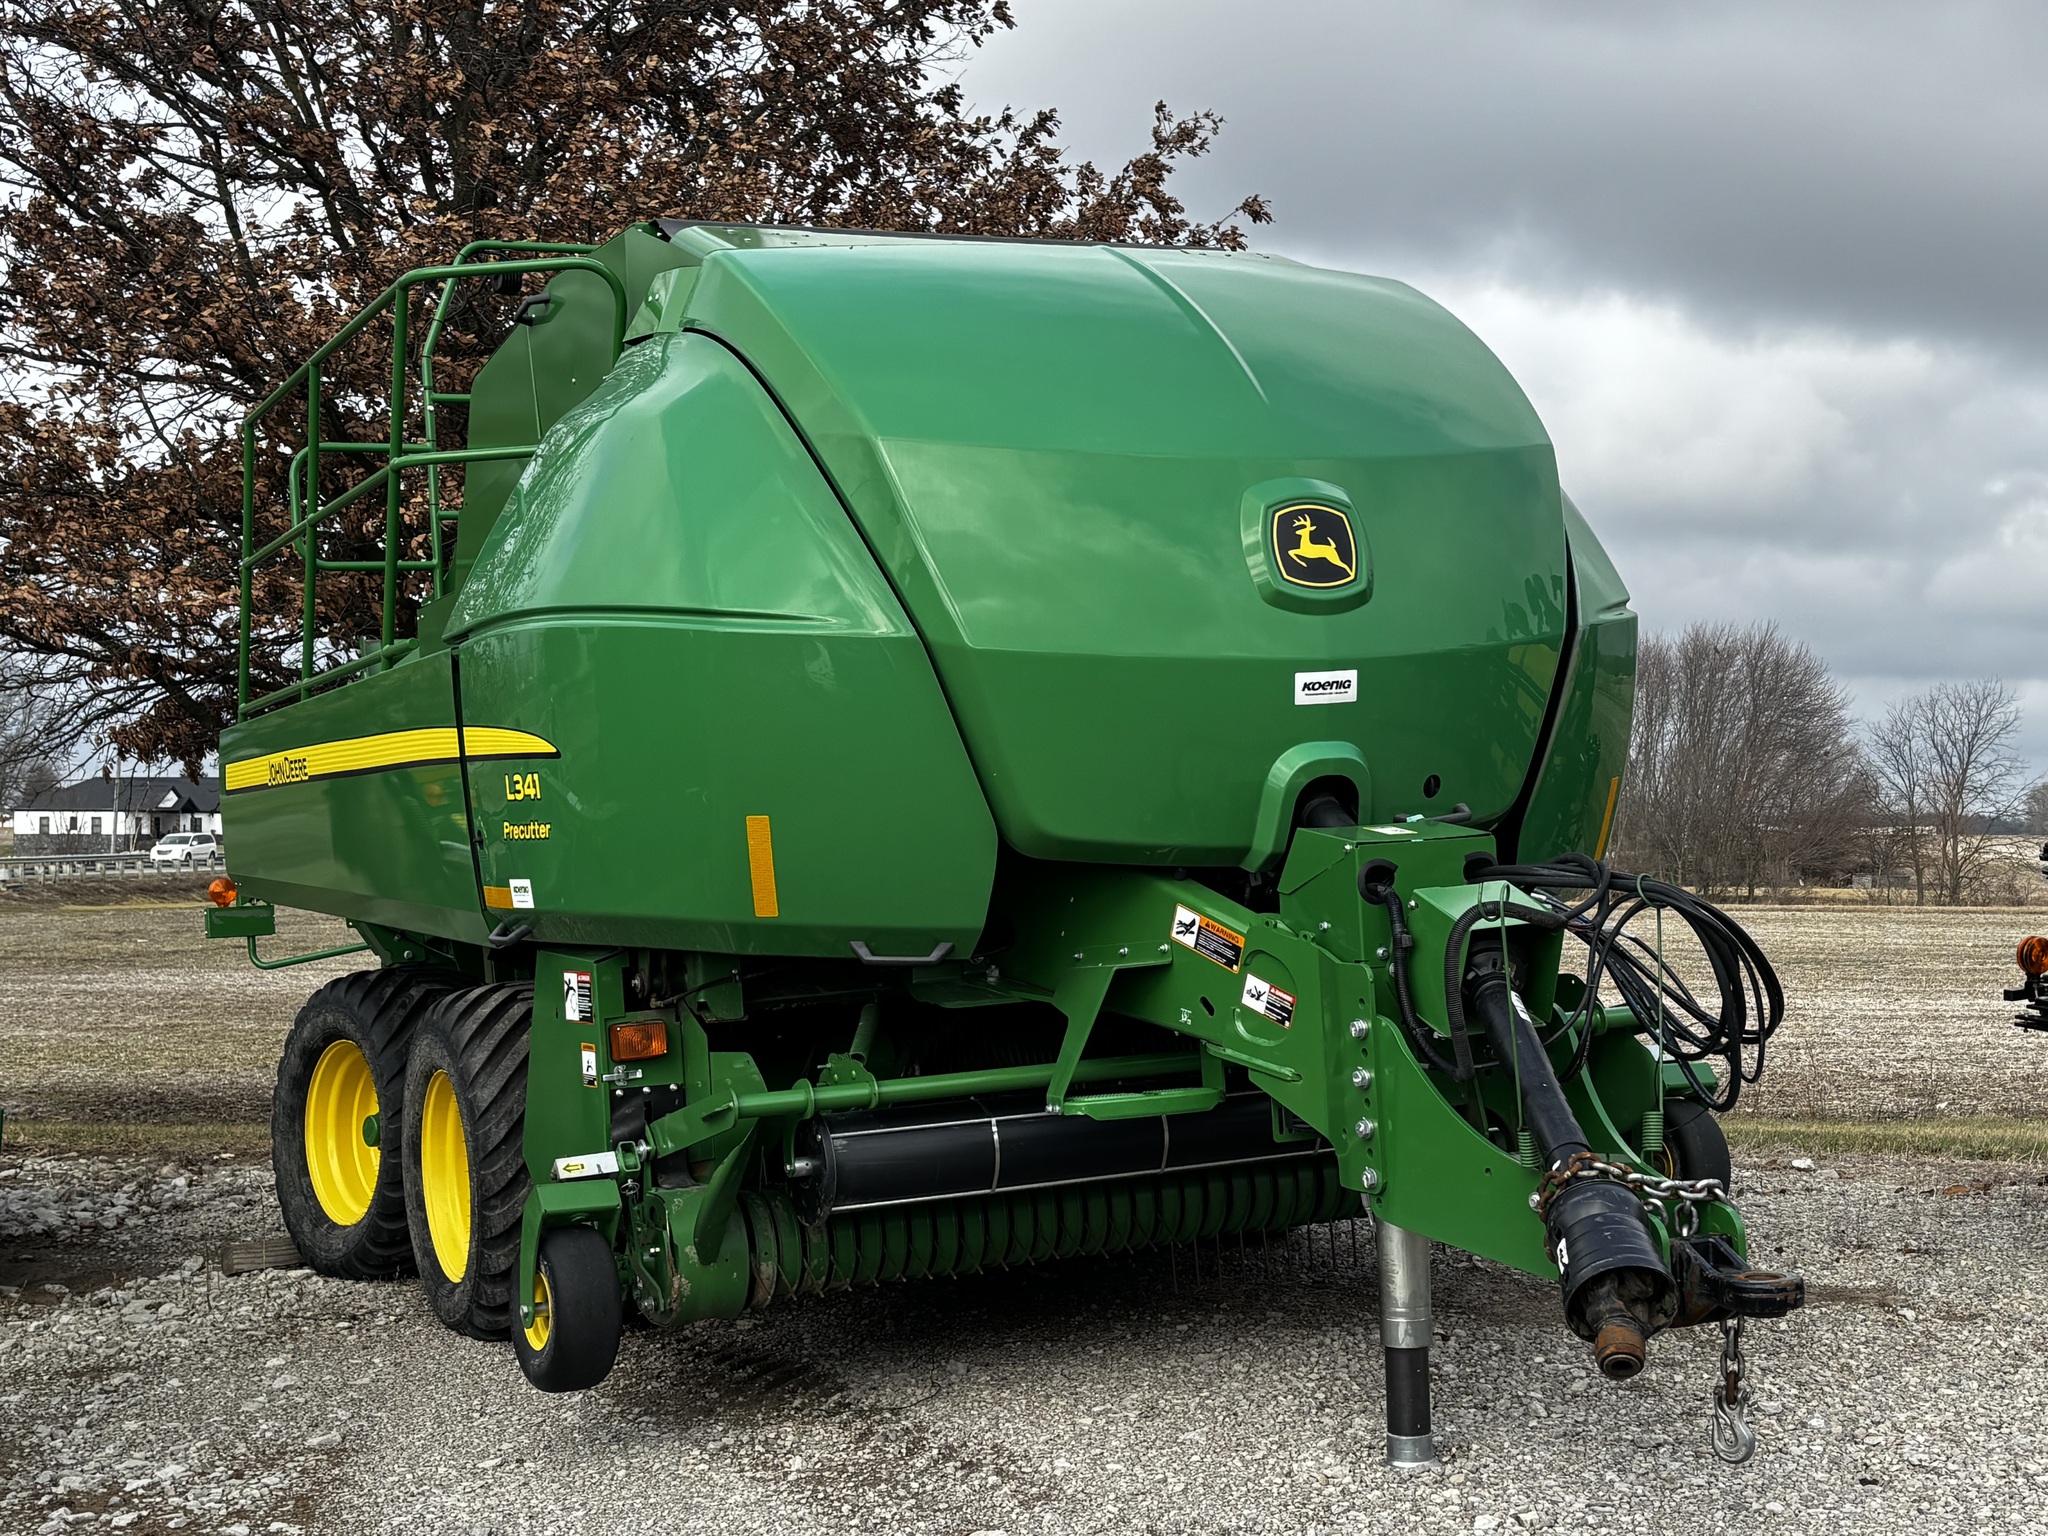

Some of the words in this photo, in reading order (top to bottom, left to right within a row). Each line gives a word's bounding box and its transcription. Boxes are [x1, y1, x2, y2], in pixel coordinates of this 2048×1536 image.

[284, 756, 308, 783] DEERE
[504, 772, 541, 801] L341
[503, 821, 551, 840] Precutter
[1210, 922, 1240, 945] WARNING
